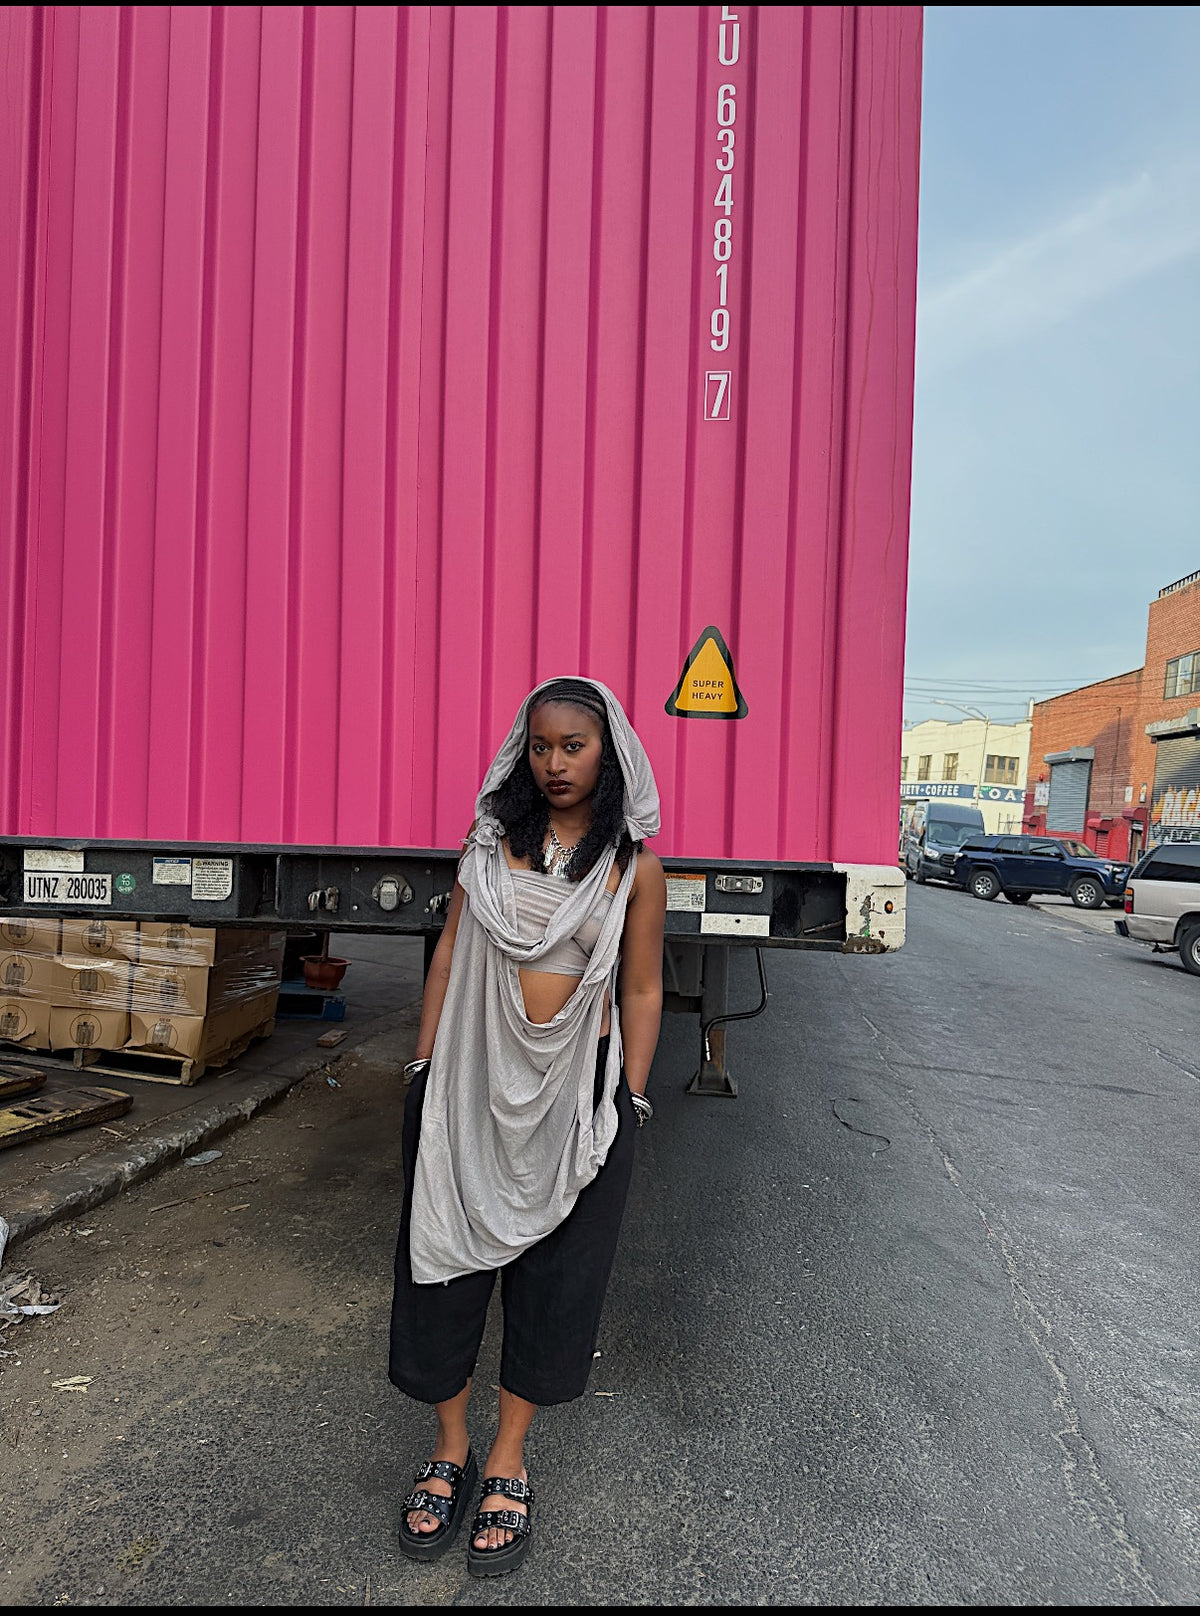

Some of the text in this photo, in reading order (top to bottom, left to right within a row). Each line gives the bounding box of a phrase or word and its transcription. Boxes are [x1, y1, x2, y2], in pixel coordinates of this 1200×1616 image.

[708, 373, 729, 417] 7
[692, 680, 725, 689] SUPER
[691, 691, 724, 701] HEAVY
[925, 784, 960, 796] COFFEE
[28, 876, 107, 900] UTNZ 280035
